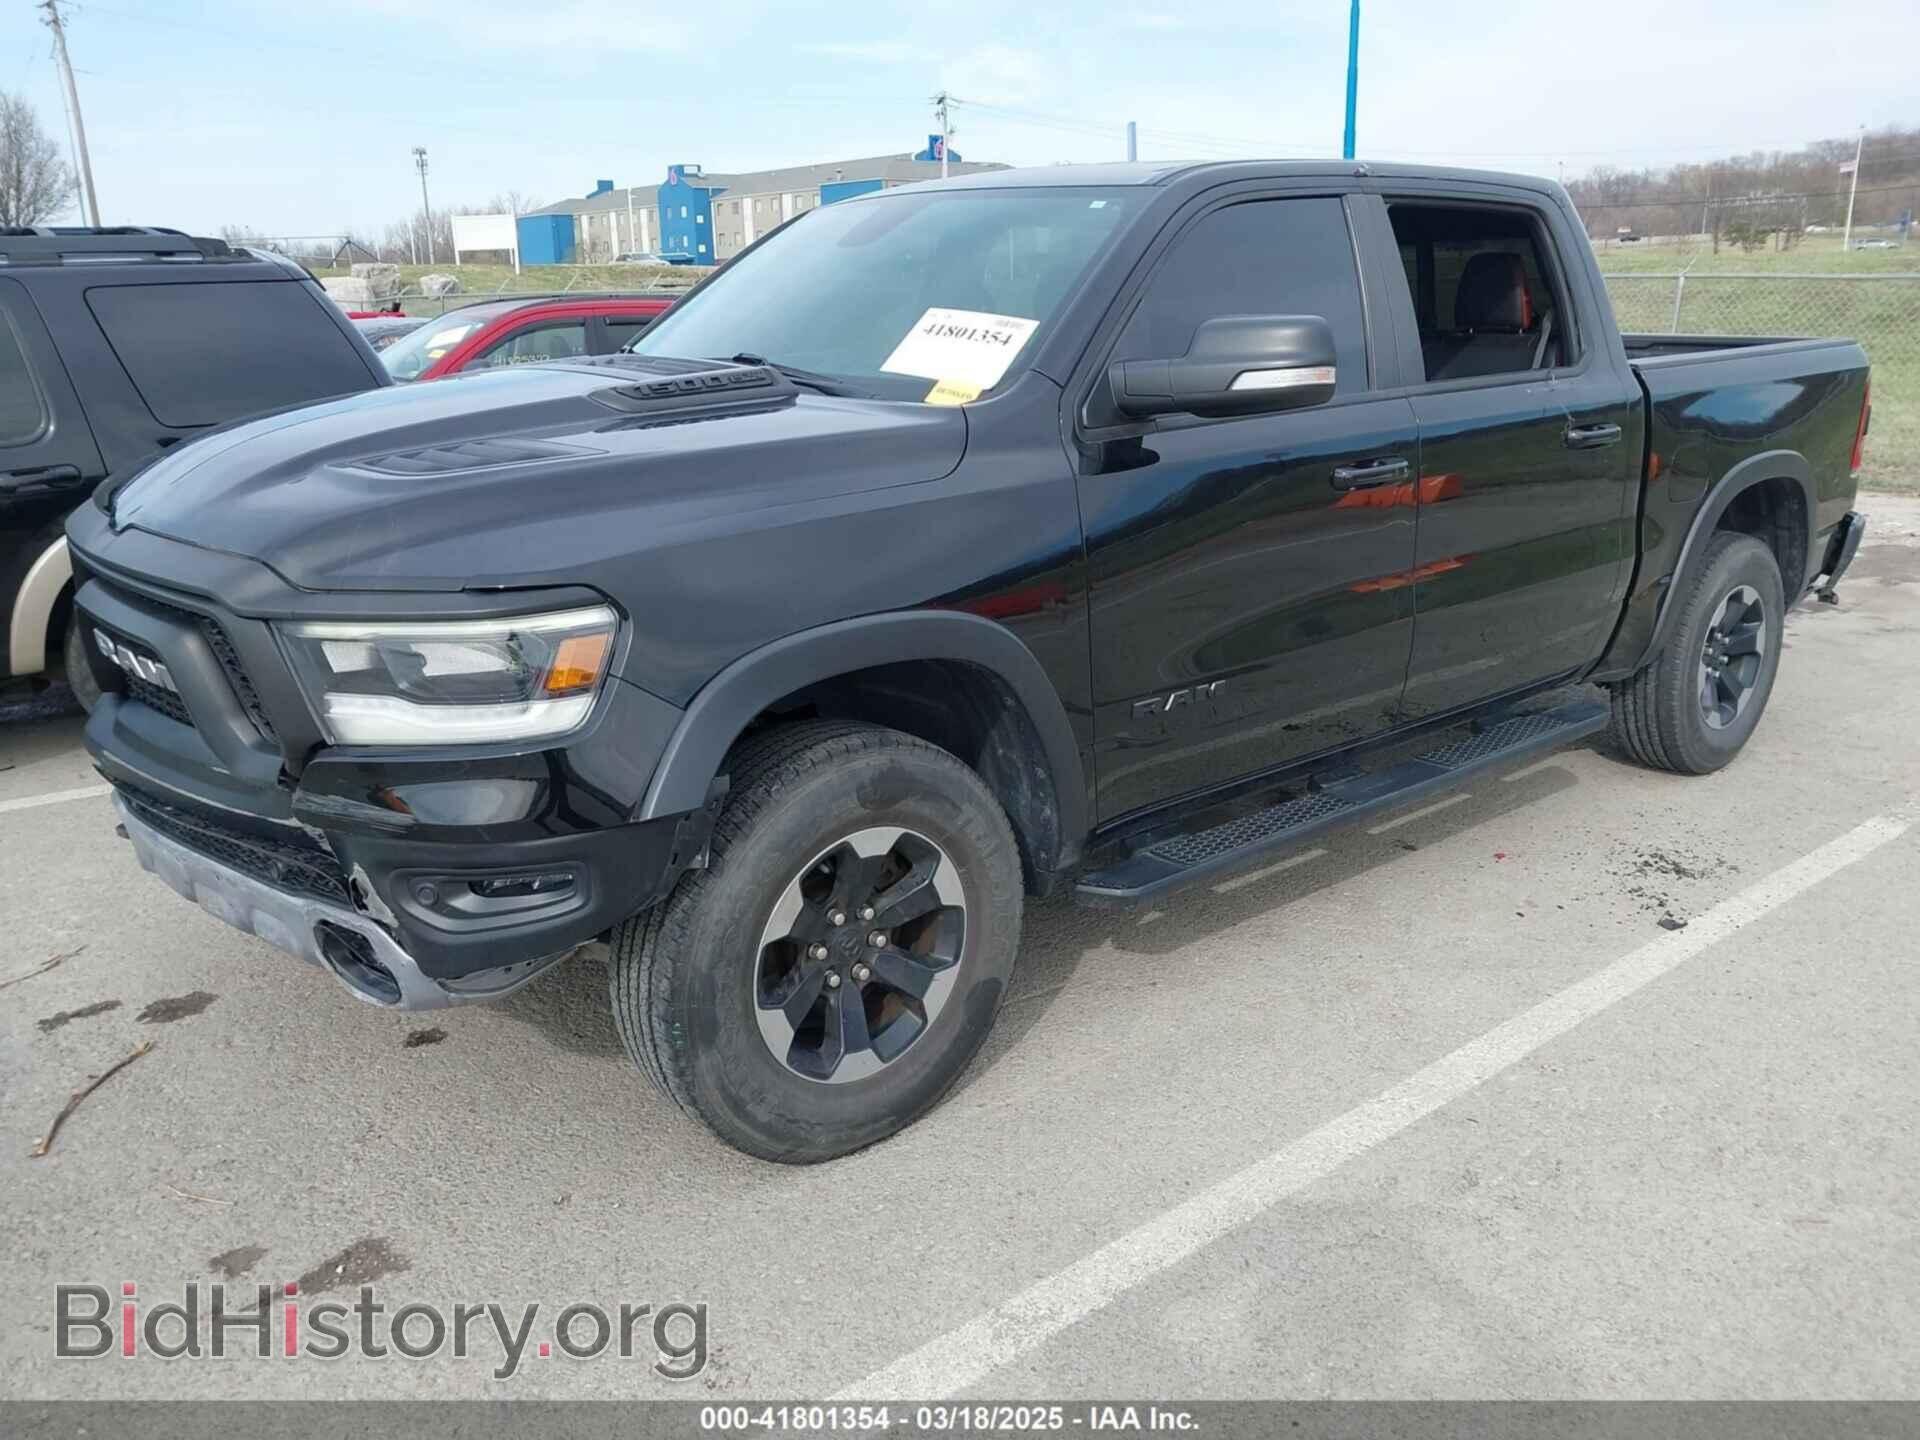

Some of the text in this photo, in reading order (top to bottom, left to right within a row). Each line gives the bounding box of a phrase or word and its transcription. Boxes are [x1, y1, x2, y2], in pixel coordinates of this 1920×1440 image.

[923, 323, 1013, 346] 41801354
[634, 376, 728, 397] 1500
[93, 628, 178, 693] RAM
[1132, 680, 1229, 719] RAM
